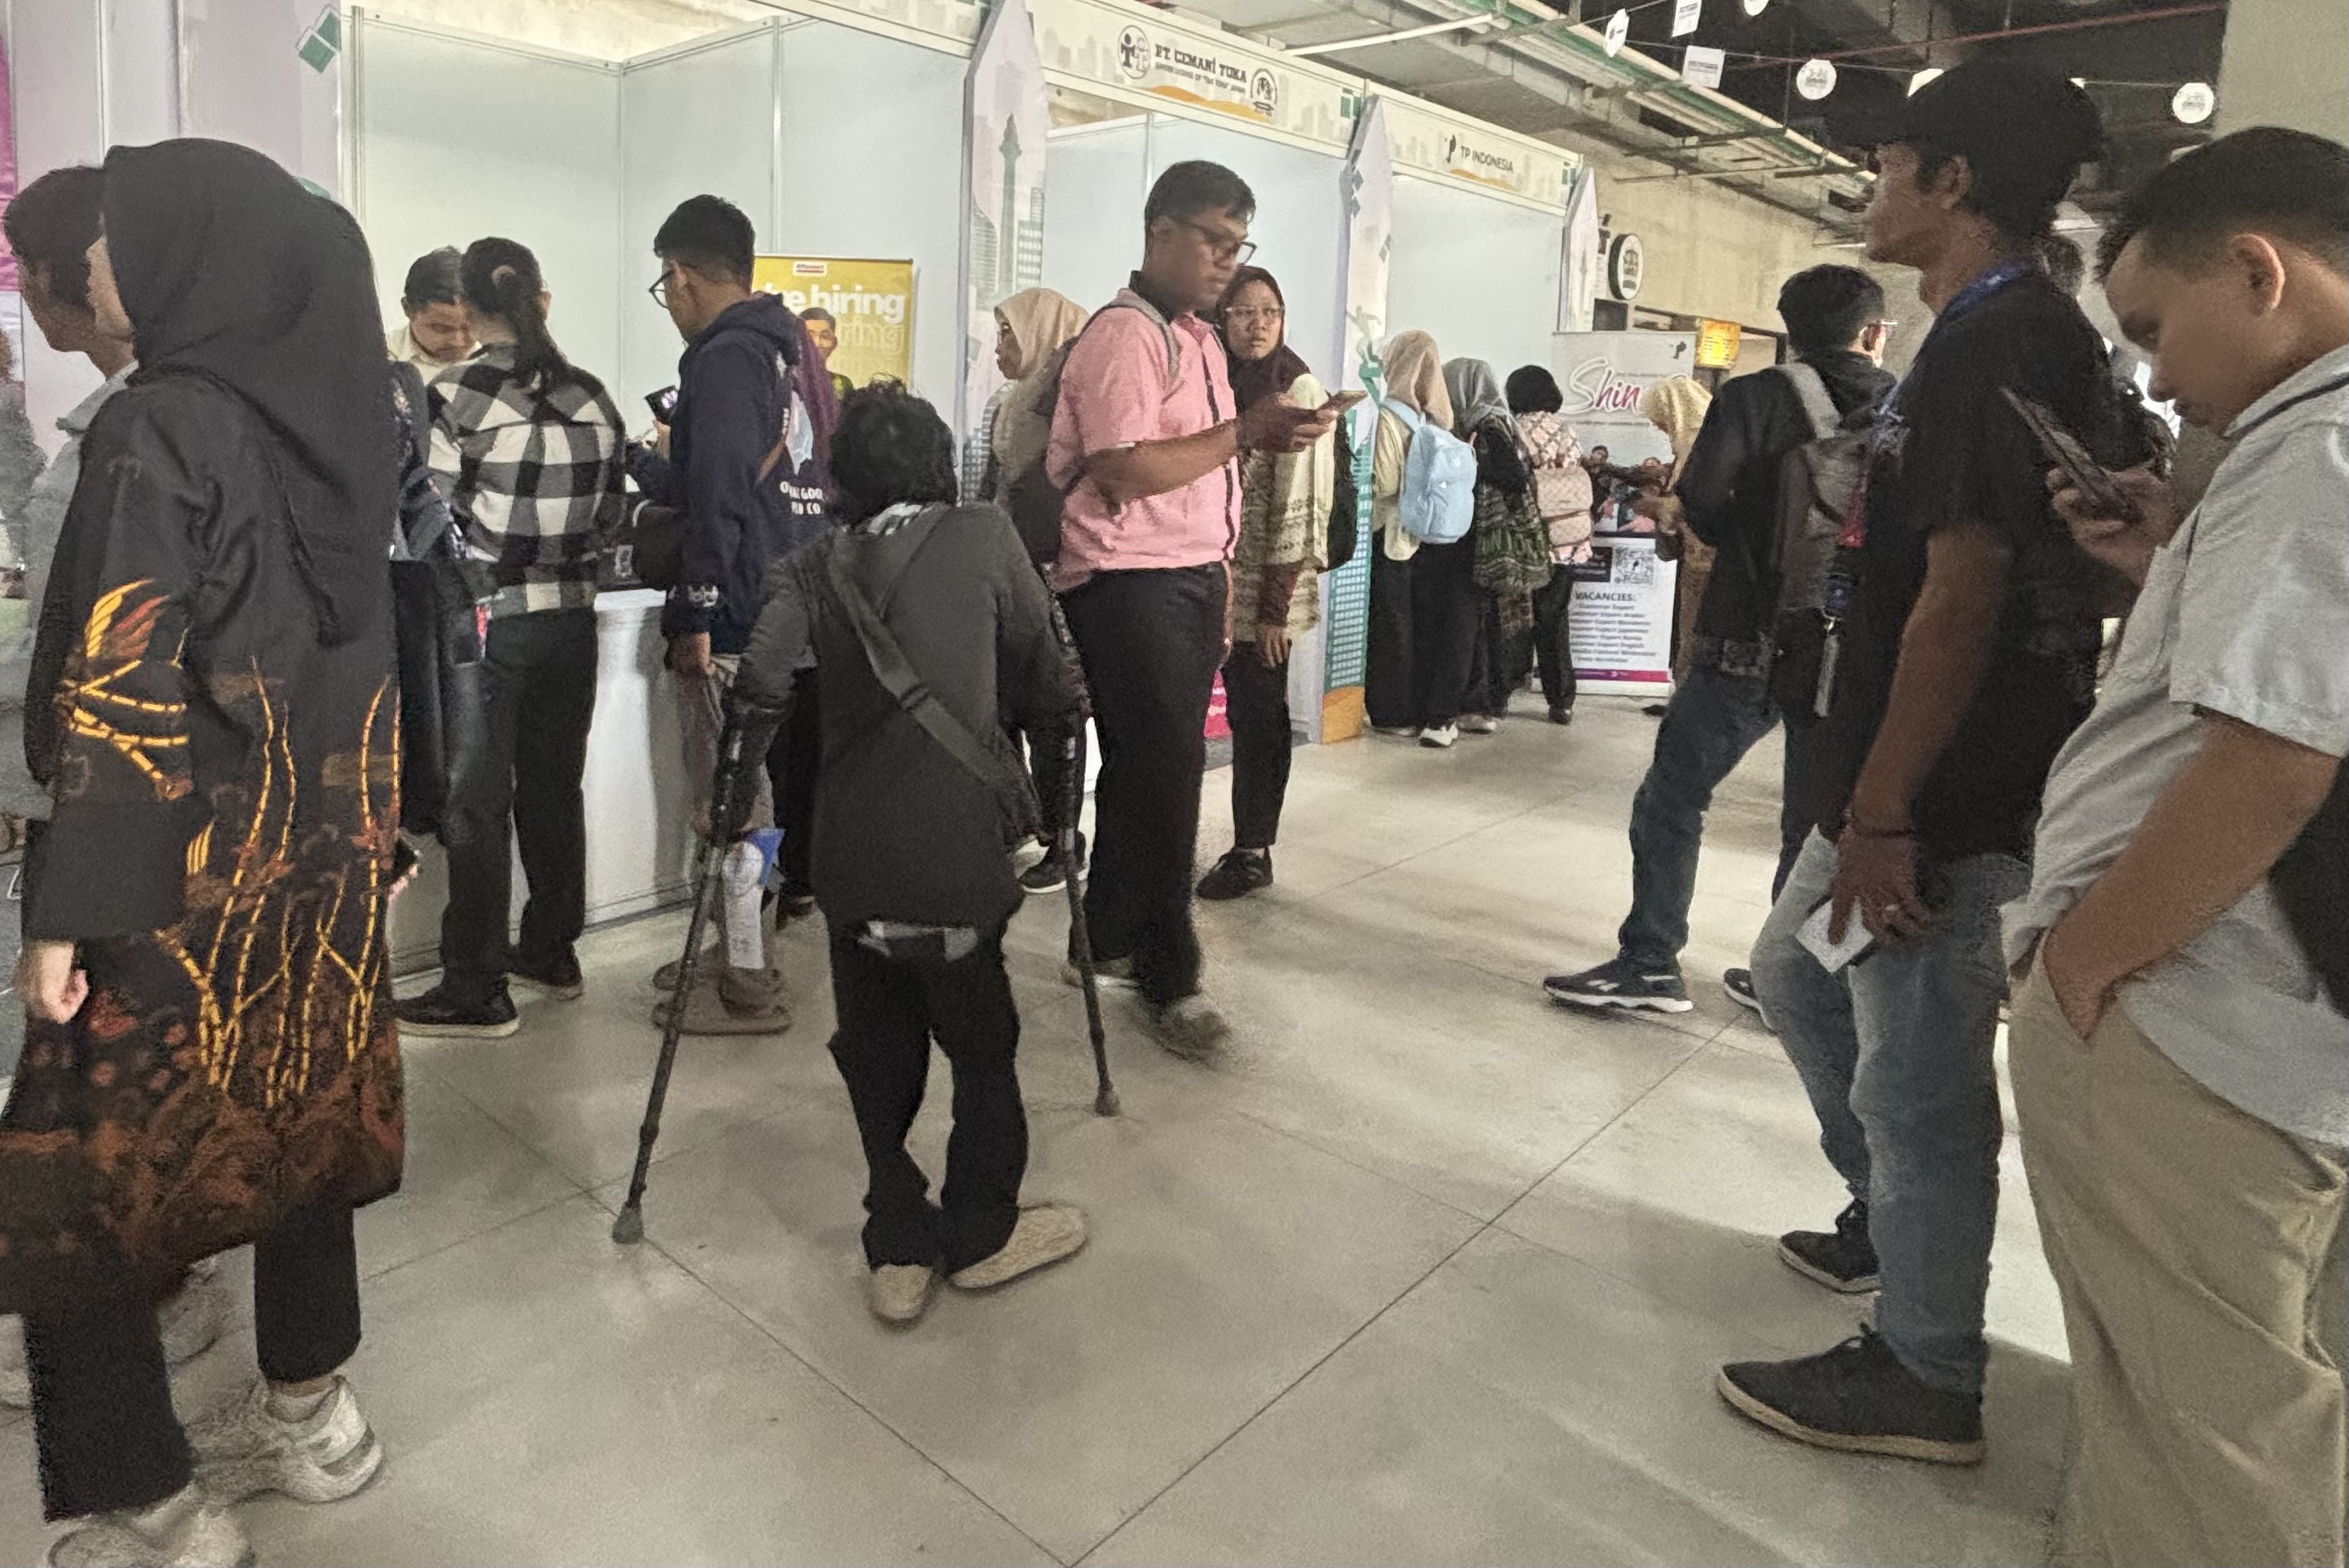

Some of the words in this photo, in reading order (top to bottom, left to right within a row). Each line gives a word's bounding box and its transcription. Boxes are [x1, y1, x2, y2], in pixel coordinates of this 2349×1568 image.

[1219, 64, 1247, 83] TOKA
[1460, 145, 1470, 159] TP
[1472, 150, 1514, 172] INDONESIA
[811, 284, 905, 324] hiring
[1559, 357, 1642, 416] Shin
